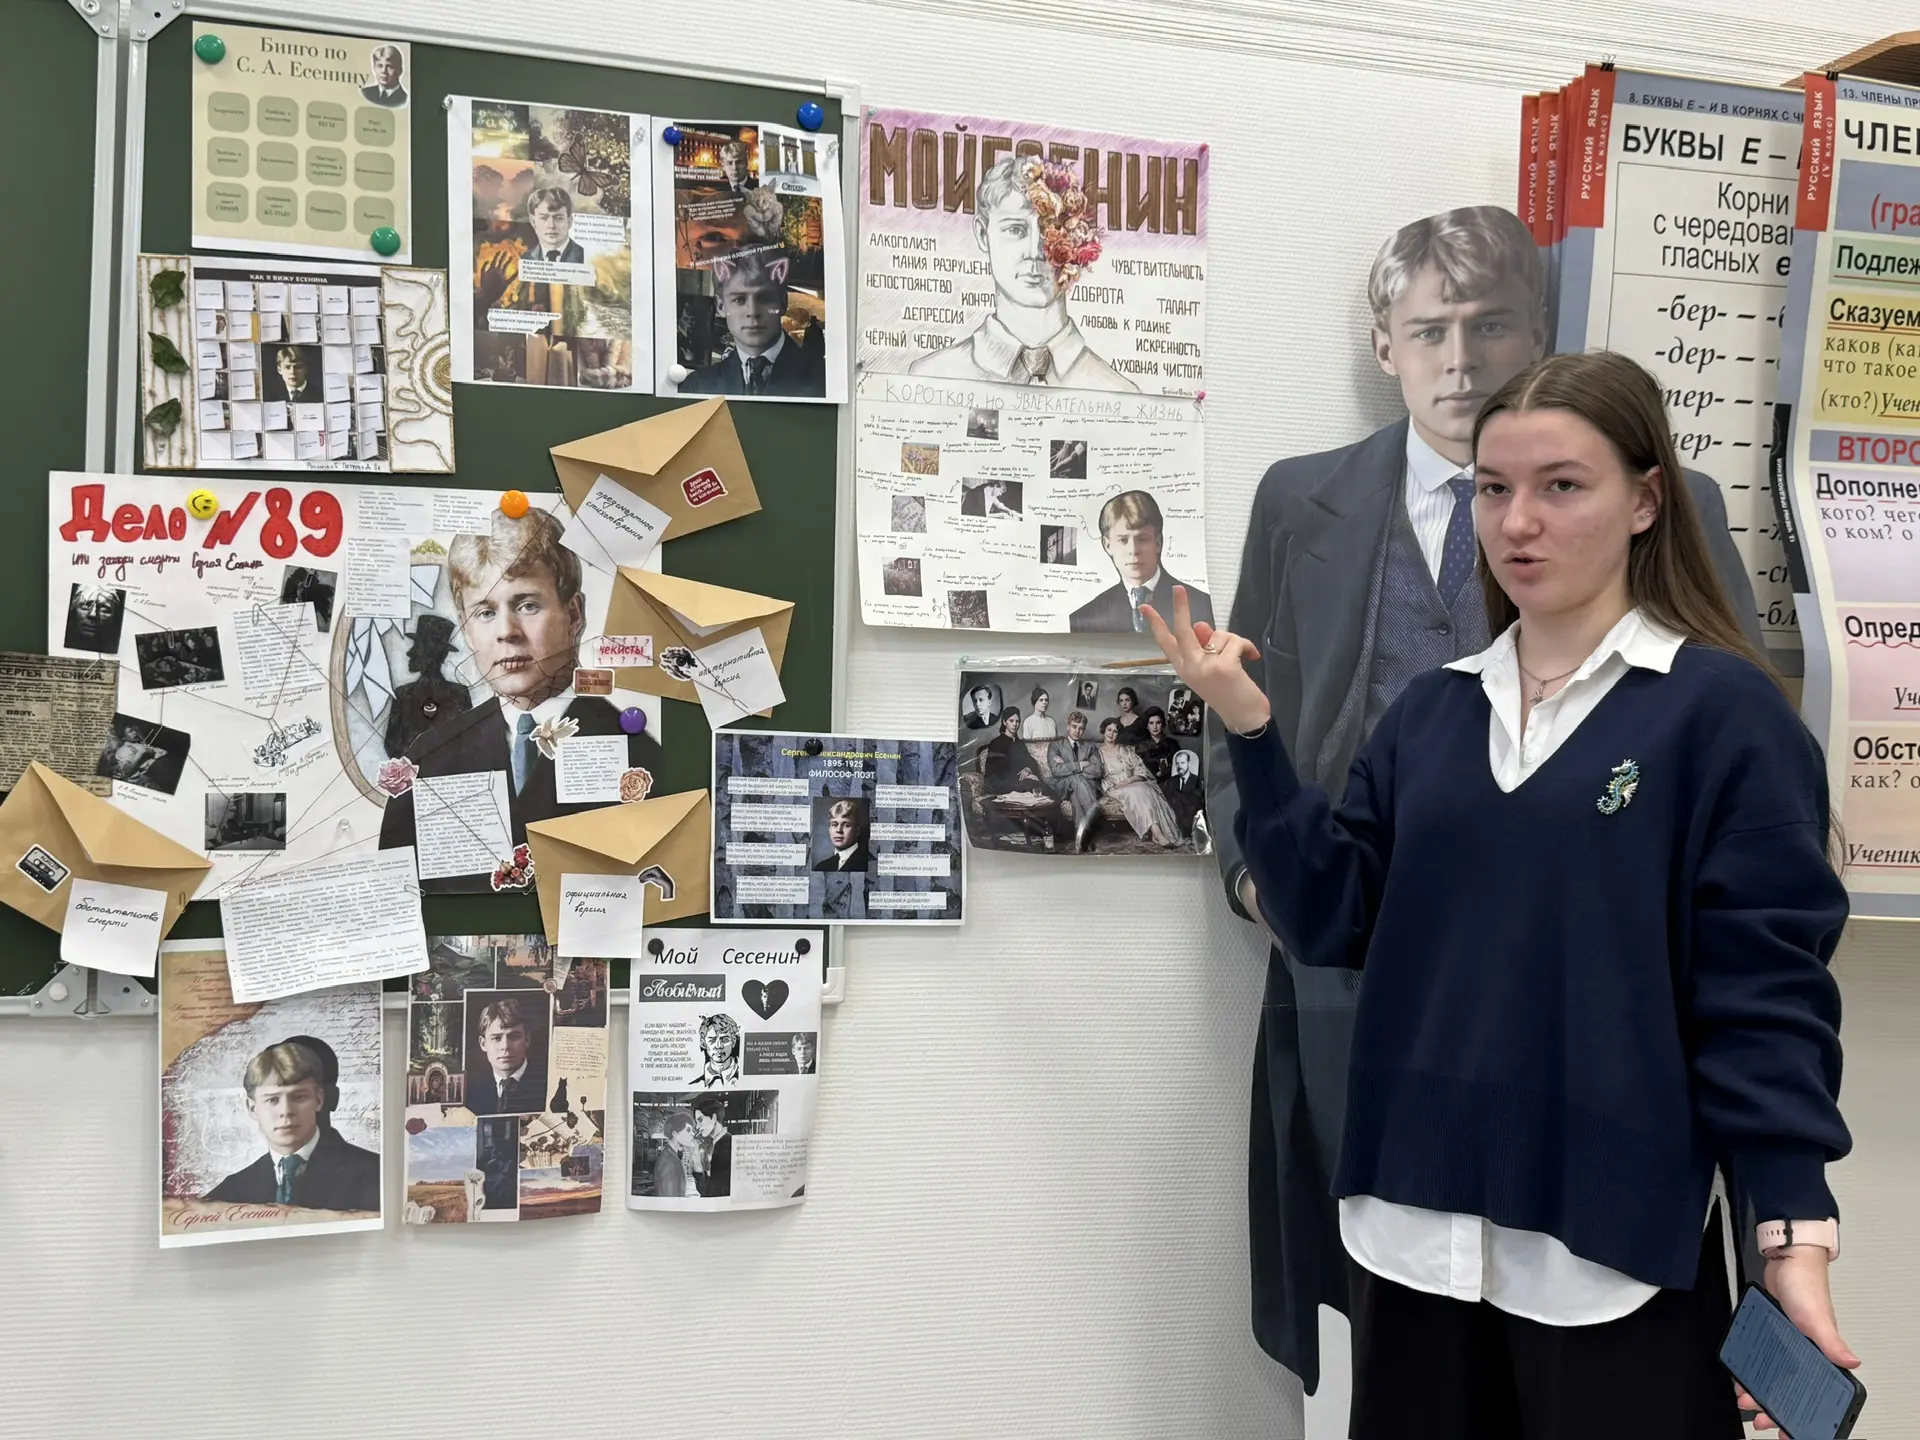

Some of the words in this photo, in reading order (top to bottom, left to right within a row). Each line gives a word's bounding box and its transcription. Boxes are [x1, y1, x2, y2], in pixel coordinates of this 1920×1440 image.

[260, 36, 318, 60] Бинго
[324, 47, 348, 61] по
[236, 55, 255, 74] С.
[263, 59, 282, 76] А.
[290, 62, 370, 90] Есенину
[1629, 93, 1639, 104] 8.
[1642, 94, 1683, 109] БУКВЫ
[1687, 100, 1696, 110] Е
[1709, 102, 1718, 113] И
[1721, 103, 1729, 114] В
[1732, 104, 1778, 120] КОРНЯХ
[1782, 110, 1789, 121] С
[1842, 88, 1858, 99] 13.
[1861, 90, 1901, 105] ЧЛЕНЫ
[1530, 117, 1540, 154] ЯЗЫК
[1549, 113, 1560, 151] ЯЗЫК
[1844, 119, 1920, 155] ЧЛЕ
[1581, 136, 1595, 200] РУССКИЙ
[1588, 88, 1600, 128] ЯЗЫК
[1622, 124, 1724, 162] БУКВЫ
[1740, 137, 1762, 165] Е
[1807, 137, 1821, 201] РУССКИЙ
[1814, 90, 1823, 130] ЯЗЫК
[869, 122, 977, 215] МОЙ
[982, 135, 1199, 236] НИН
[1546, 160, 1557, 221] РУССКИЙ
[1718, 182, 1789, 218] Корни
[1653, 214, 1667, 235] с
[869, 232, 938, 252] АЛКОГОЛИЗМ
[892, 254, 928, 271] МАНИЯ
[1111, 259, 1204, 282] ЧУВСТВИТЕЛЬНОСТЬ
[1661, 245, 1760, 274] гласных
[295, 276, 328, 284] ЕСЕНИНА
[866, 273, 953, 294] НЕПОСТОЯНСТВО
[1070, 284, 1124, 306] ДОБРОТА
[902, 307, 965, 325] ДЕПРЕССИЯ
[1156, 297, 1201, 317] ТАЛАНТ
[1657, 294, 1727, 331] -бер-
[1080, 315, 1118, 331] ЛЮБОВЬ
[1123, 320, 1131, 332] К
[1135, 319, 1172, 335] РОДИНЕ
[865, 330, 907, 348] ЧЁРНЫЙ
[913, 333, 957, 350] ЧЕЛОВЕК
[1135, 338, 1201, 358] ИСКРЕННОСТЬ
[1825, 337, 1880, 355] каков
[1654, 336, 1726, 374] -дер-
[1109, 357, 1159, 376] ДУХОВНАЯ
[1163, 361, 1204, 380] ЧИСТОТА
[1823, 359, 1856, 374] что
[1863, 362, 1918, 379] такое
[985, 395, 1005, 410] НО
[1014, 387, 1122, 415] УВЛЕКАТЕЛЬНАЯ
[1136, 402, 1184, 422] ЖИЗНЬ
[1821, 388, 1878, 416] (кто?)
[1816, 473, 1920, 500] Дополне
[59, 484, 187, 543] Дело
[585, 500, 644, 541] стихотворение
[595, 489, 654, 531] предсмертное
[1820, 504, 1875, 521] кого?
[1884, 510, 1920, 523] чег
[1825, 526, 1837, 539] о
[1845, 524, 1893, 540] ком?
[1902, 529, 1913, 541] о
[140, 556, 181, 574] смерти
[699, 647, 766, 677] альтернативная
[713, 671, 741, 691] версия
[875, 752, 901, 760] Есенин
[1853, 736, 1920, 760] Обст
[808, 769, 876, 780] ФИЛОСОФ-ПОЭТ
[822, 759, 864, 769] 1895-1925
[1850, 769, 1902, 789] как?
[565, 889, 628, 905] официальная
[75, 896, 159, 922] обстоятельства
[574, 902, 607, 918] версия
[87, 916, 129, 931] смерти
[655, 947, 698, 965] Мой
[722, 948, 801, 965] Сесенин
[169, 1207, 221, 1230] Сергей
[226, 1204, 280, 1221] Есенин
